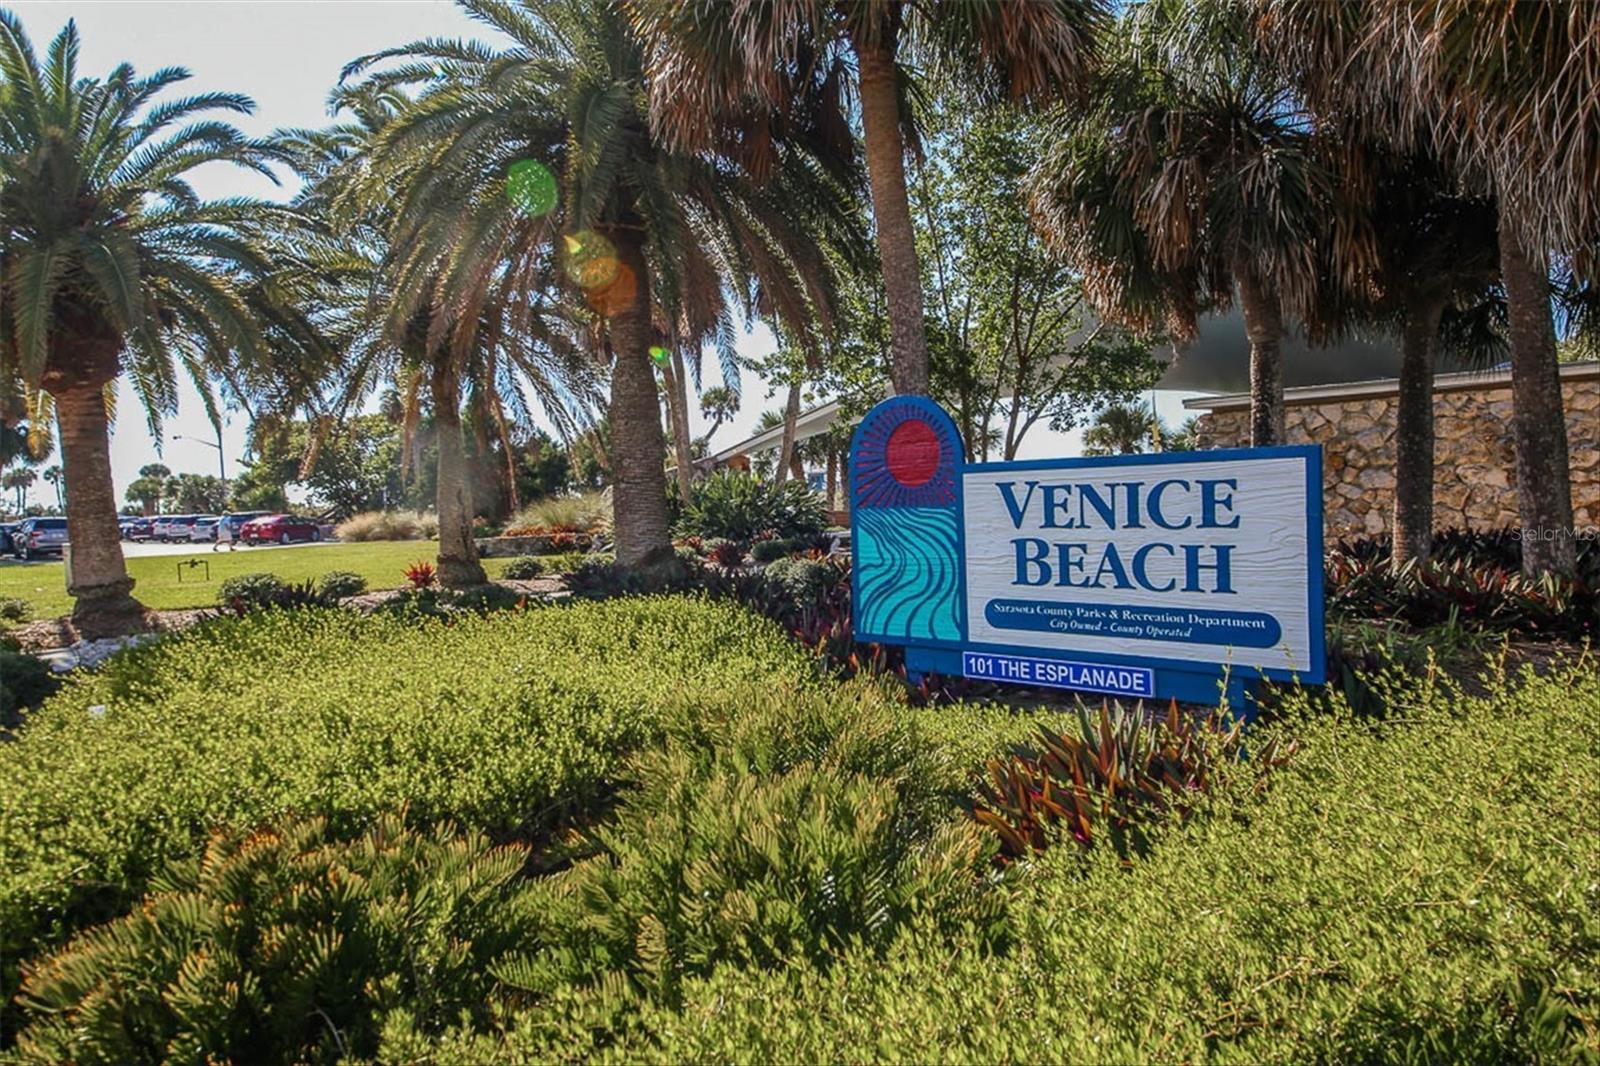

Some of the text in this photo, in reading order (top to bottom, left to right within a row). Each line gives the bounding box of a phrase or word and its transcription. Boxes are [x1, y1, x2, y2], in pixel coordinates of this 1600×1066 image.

[995, 479, 1240, 530] VENICE
[1010, 537, 1237, 594] BEACH
[993, 603, 1266, 630] Sarasota County Parks & Recreation Department
[1049, 618, 1068, 631] City
[1070, 620, 1102, 631] Owned
[1110, 622, 1143, 636] County
[1146, 625, 1193, 638] Operated
[968, 657, 1145, 691] 101 THE ESPLANADE
